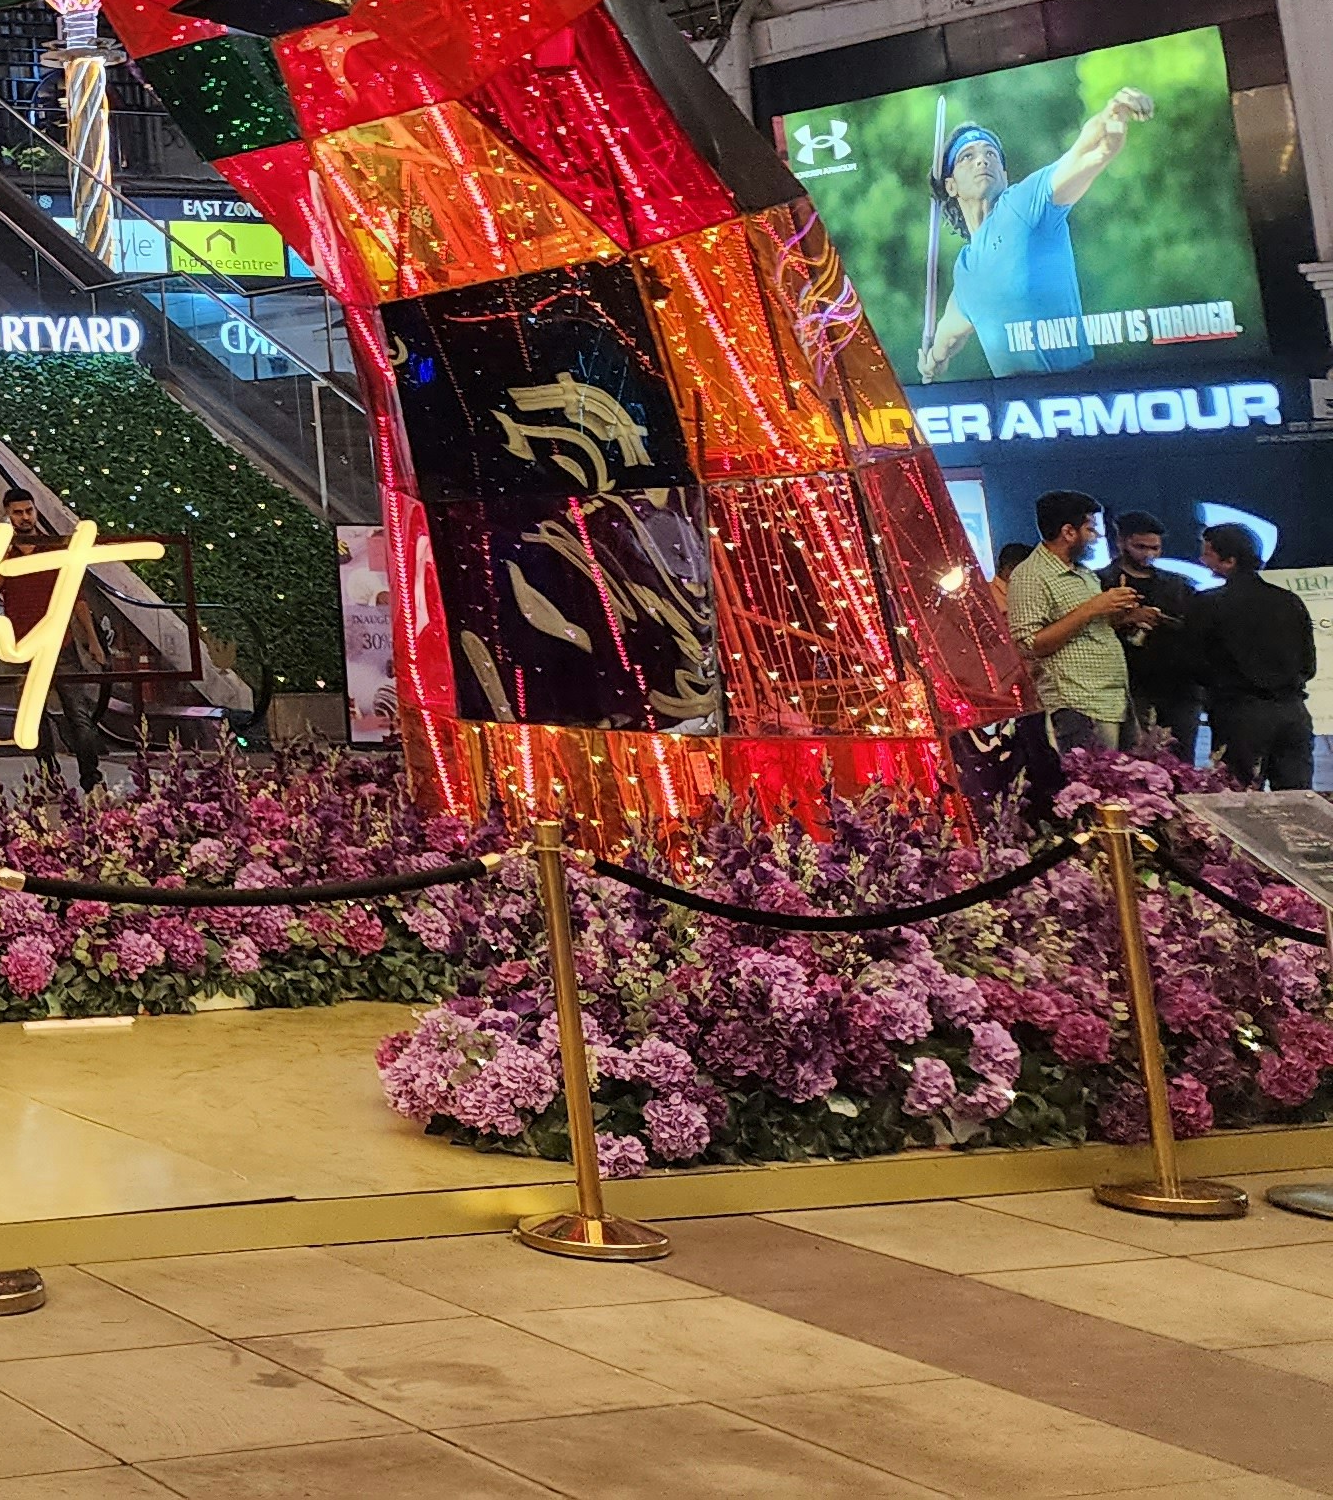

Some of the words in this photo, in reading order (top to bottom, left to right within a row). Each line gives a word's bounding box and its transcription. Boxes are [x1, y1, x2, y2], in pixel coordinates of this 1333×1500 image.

[183, 199, 222, 221] EAST
[223, 201, 263, 218] ZON
[1004, 320, 1035, 352] THE
[1037, 316, 1078, 350] ONLY
[1081, 312, 1123, 345] WAY
[1125, 309, 1148, 342] IS
[999, 381, 1282, 439] ARMOUR
